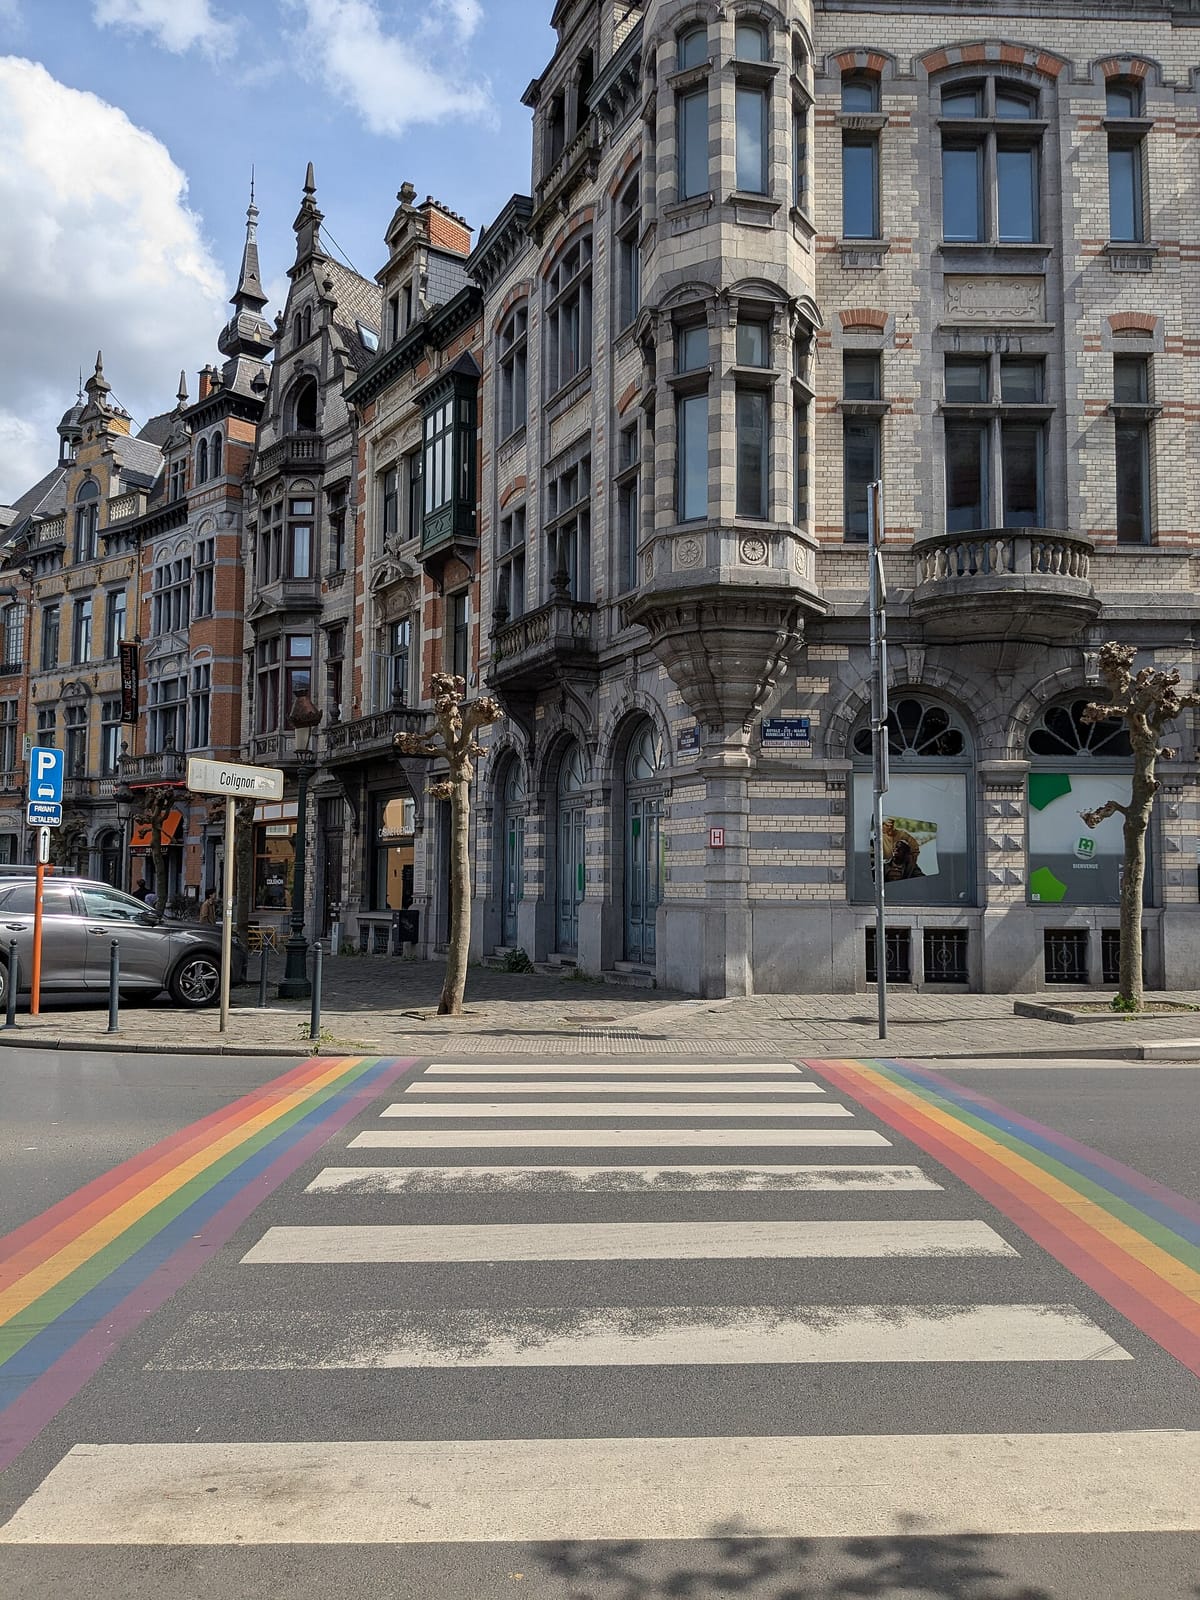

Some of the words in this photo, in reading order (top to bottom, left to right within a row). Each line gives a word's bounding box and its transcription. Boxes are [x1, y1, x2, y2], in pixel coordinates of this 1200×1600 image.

[37, 751, 57, 780] P
[220, 772, 255, 790] Colignon
[34, 804, 56, 813] PAYANT
[29, 816, 60, 825] BETALEND
[713, 832, 720, 843] H
